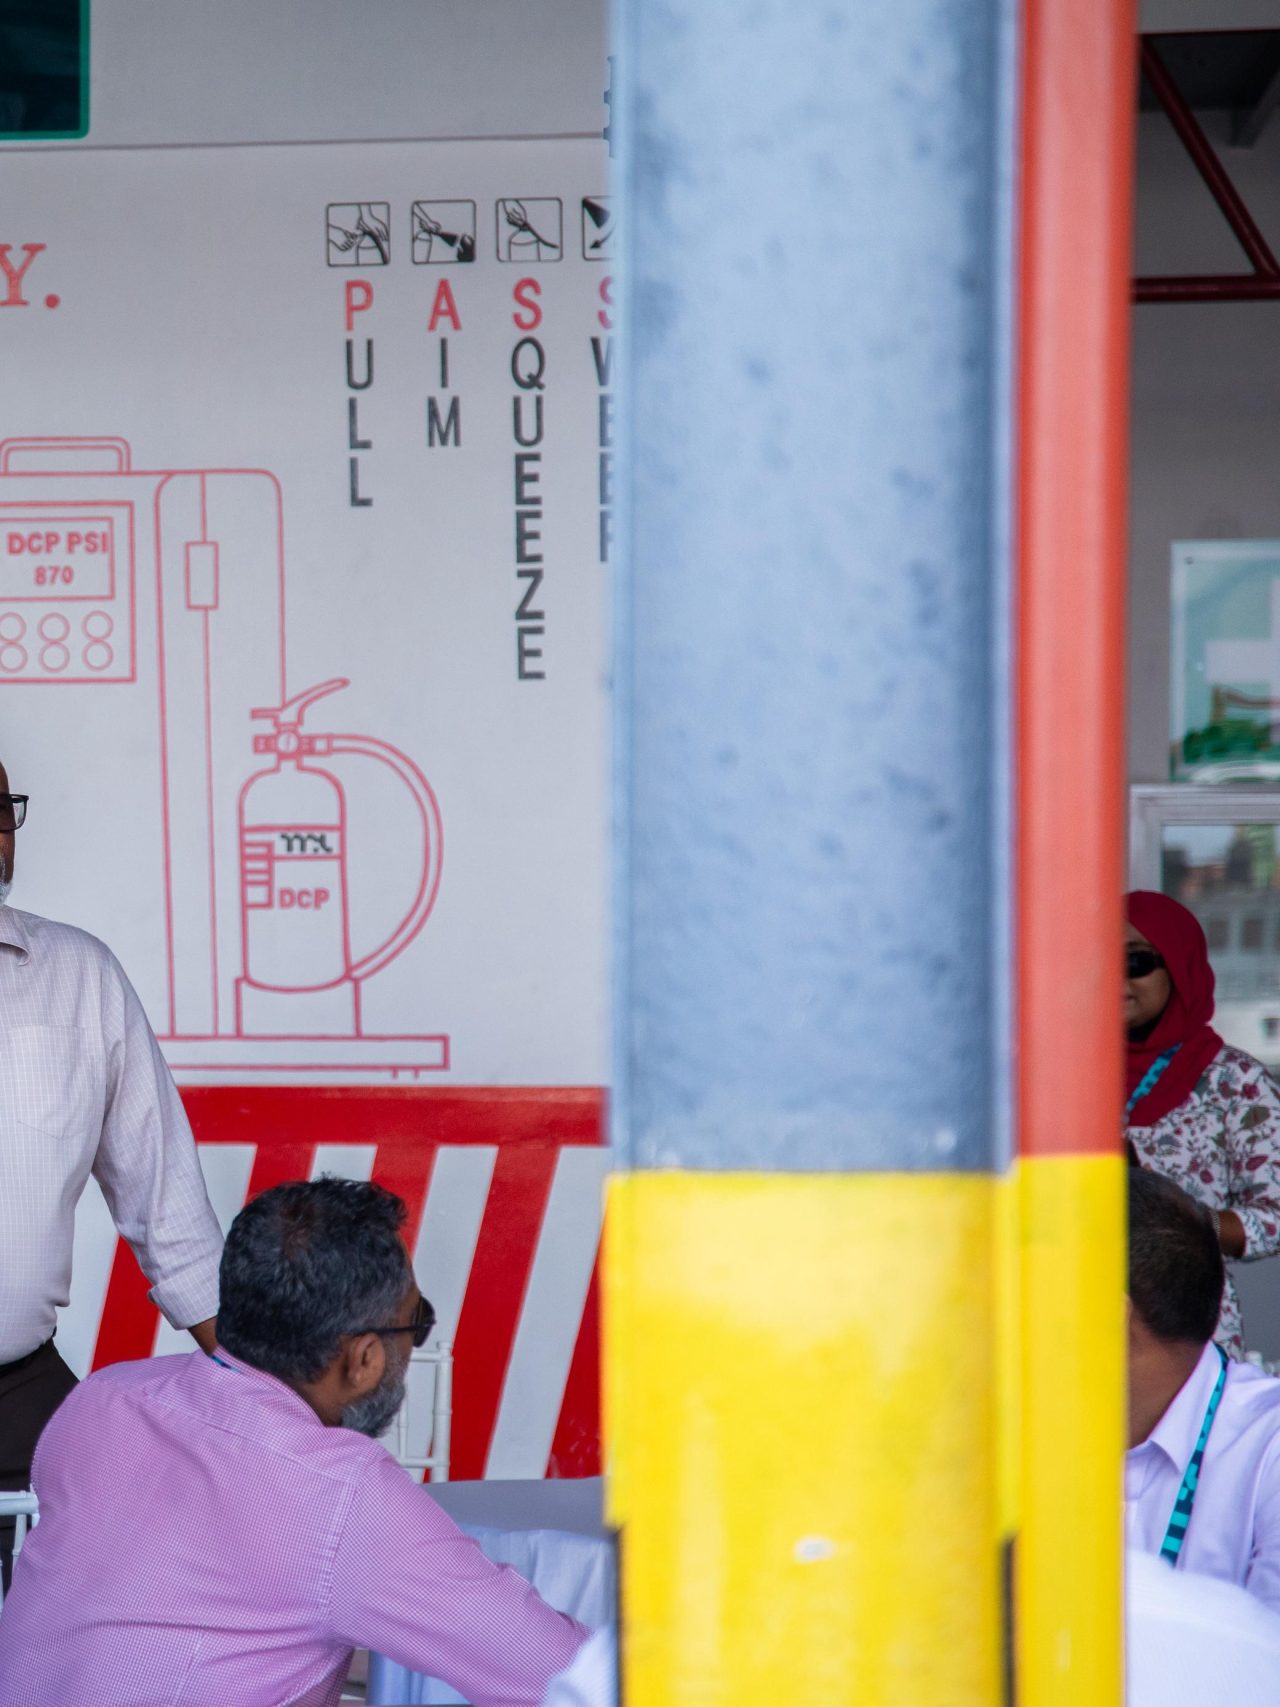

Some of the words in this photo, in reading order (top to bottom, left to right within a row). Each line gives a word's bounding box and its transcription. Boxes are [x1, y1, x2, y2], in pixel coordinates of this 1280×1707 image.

[344, 279, 374, 507] PULL
[426, 279, 462, 447] AIM
[510, 277, 545, 680] SQUEEZE
[6, 532, 61, 556] DCP
[65, 531, 108, 555] PSI
[33, 565, 75, 587] 870
[278, 887, 331, 910] DCP
